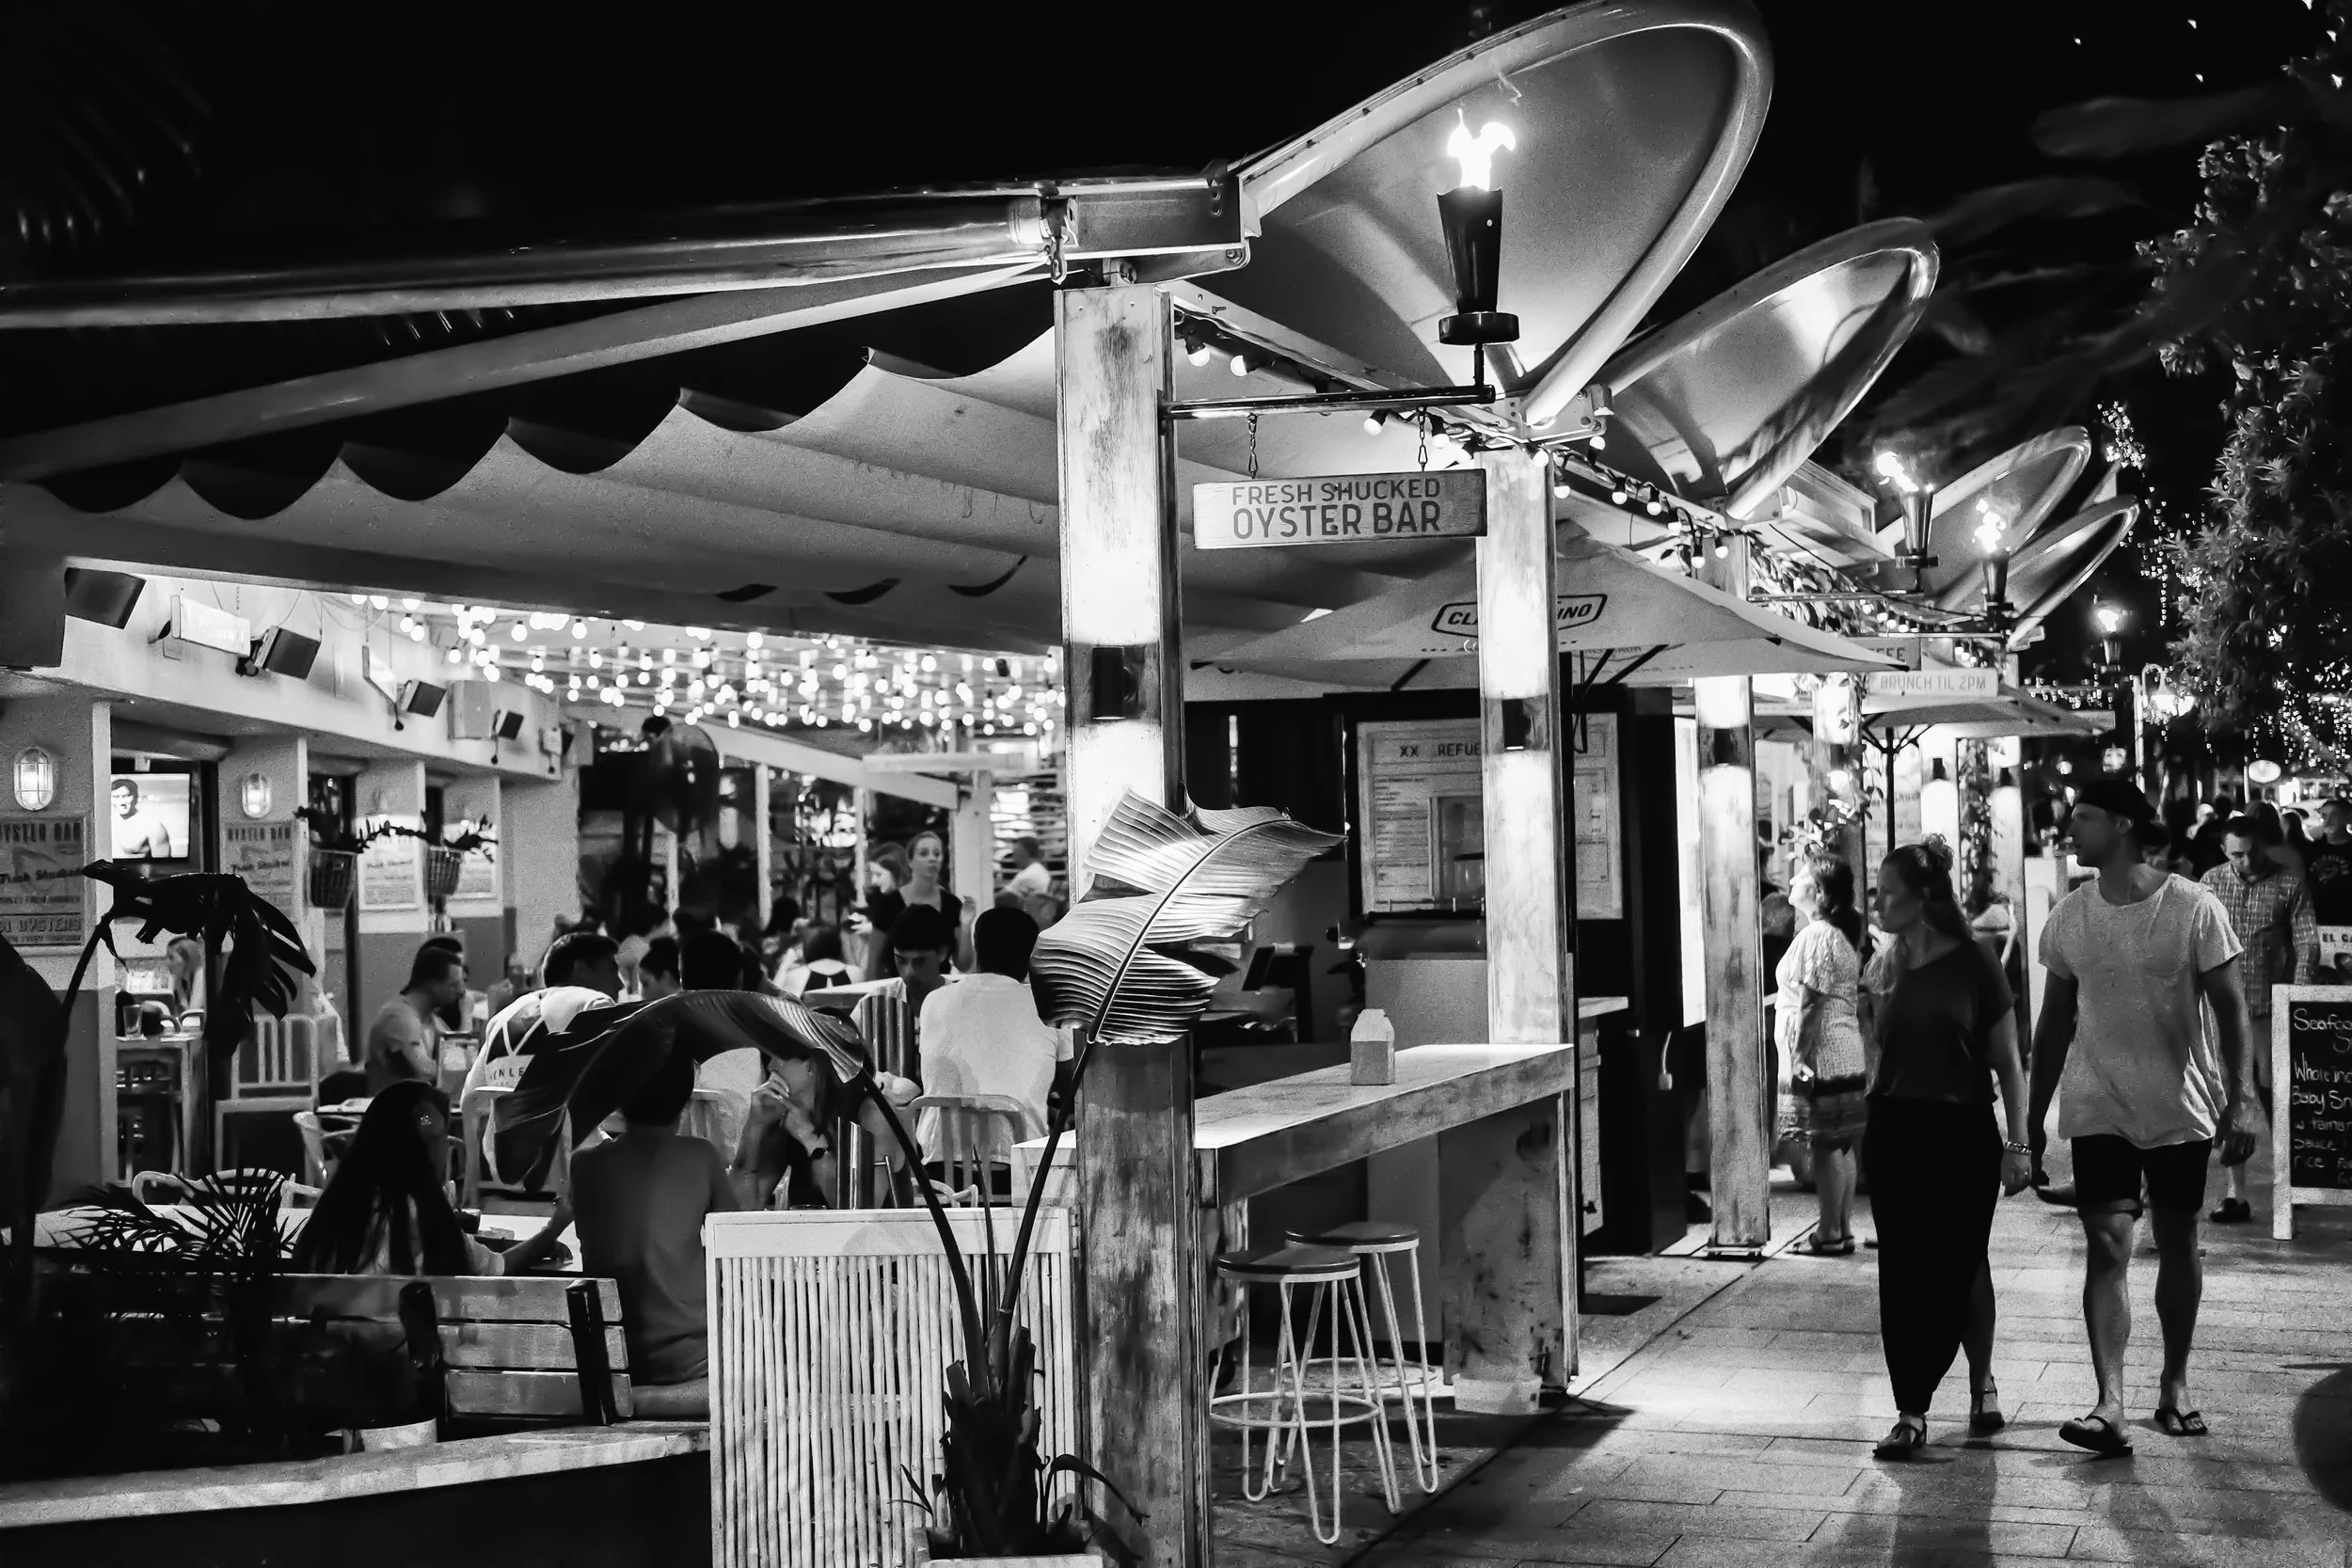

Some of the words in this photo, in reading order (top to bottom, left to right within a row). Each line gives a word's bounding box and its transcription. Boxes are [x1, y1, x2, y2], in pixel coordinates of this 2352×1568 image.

[1232, 483, 1312, 506] FRESH
[1321, 478, 1441, 501] SHUCKED
[1232, 504, 1362, 539] OYSTER
[1373, 500, 1441, 534] BAR
[1881, 675, 1932, 690] BRUNCH
[1937, 675, 1955, 689] TIL
[1960, 675, 1986, 690] 2PM
[2292, 1085, 2326, 1115] Baby
